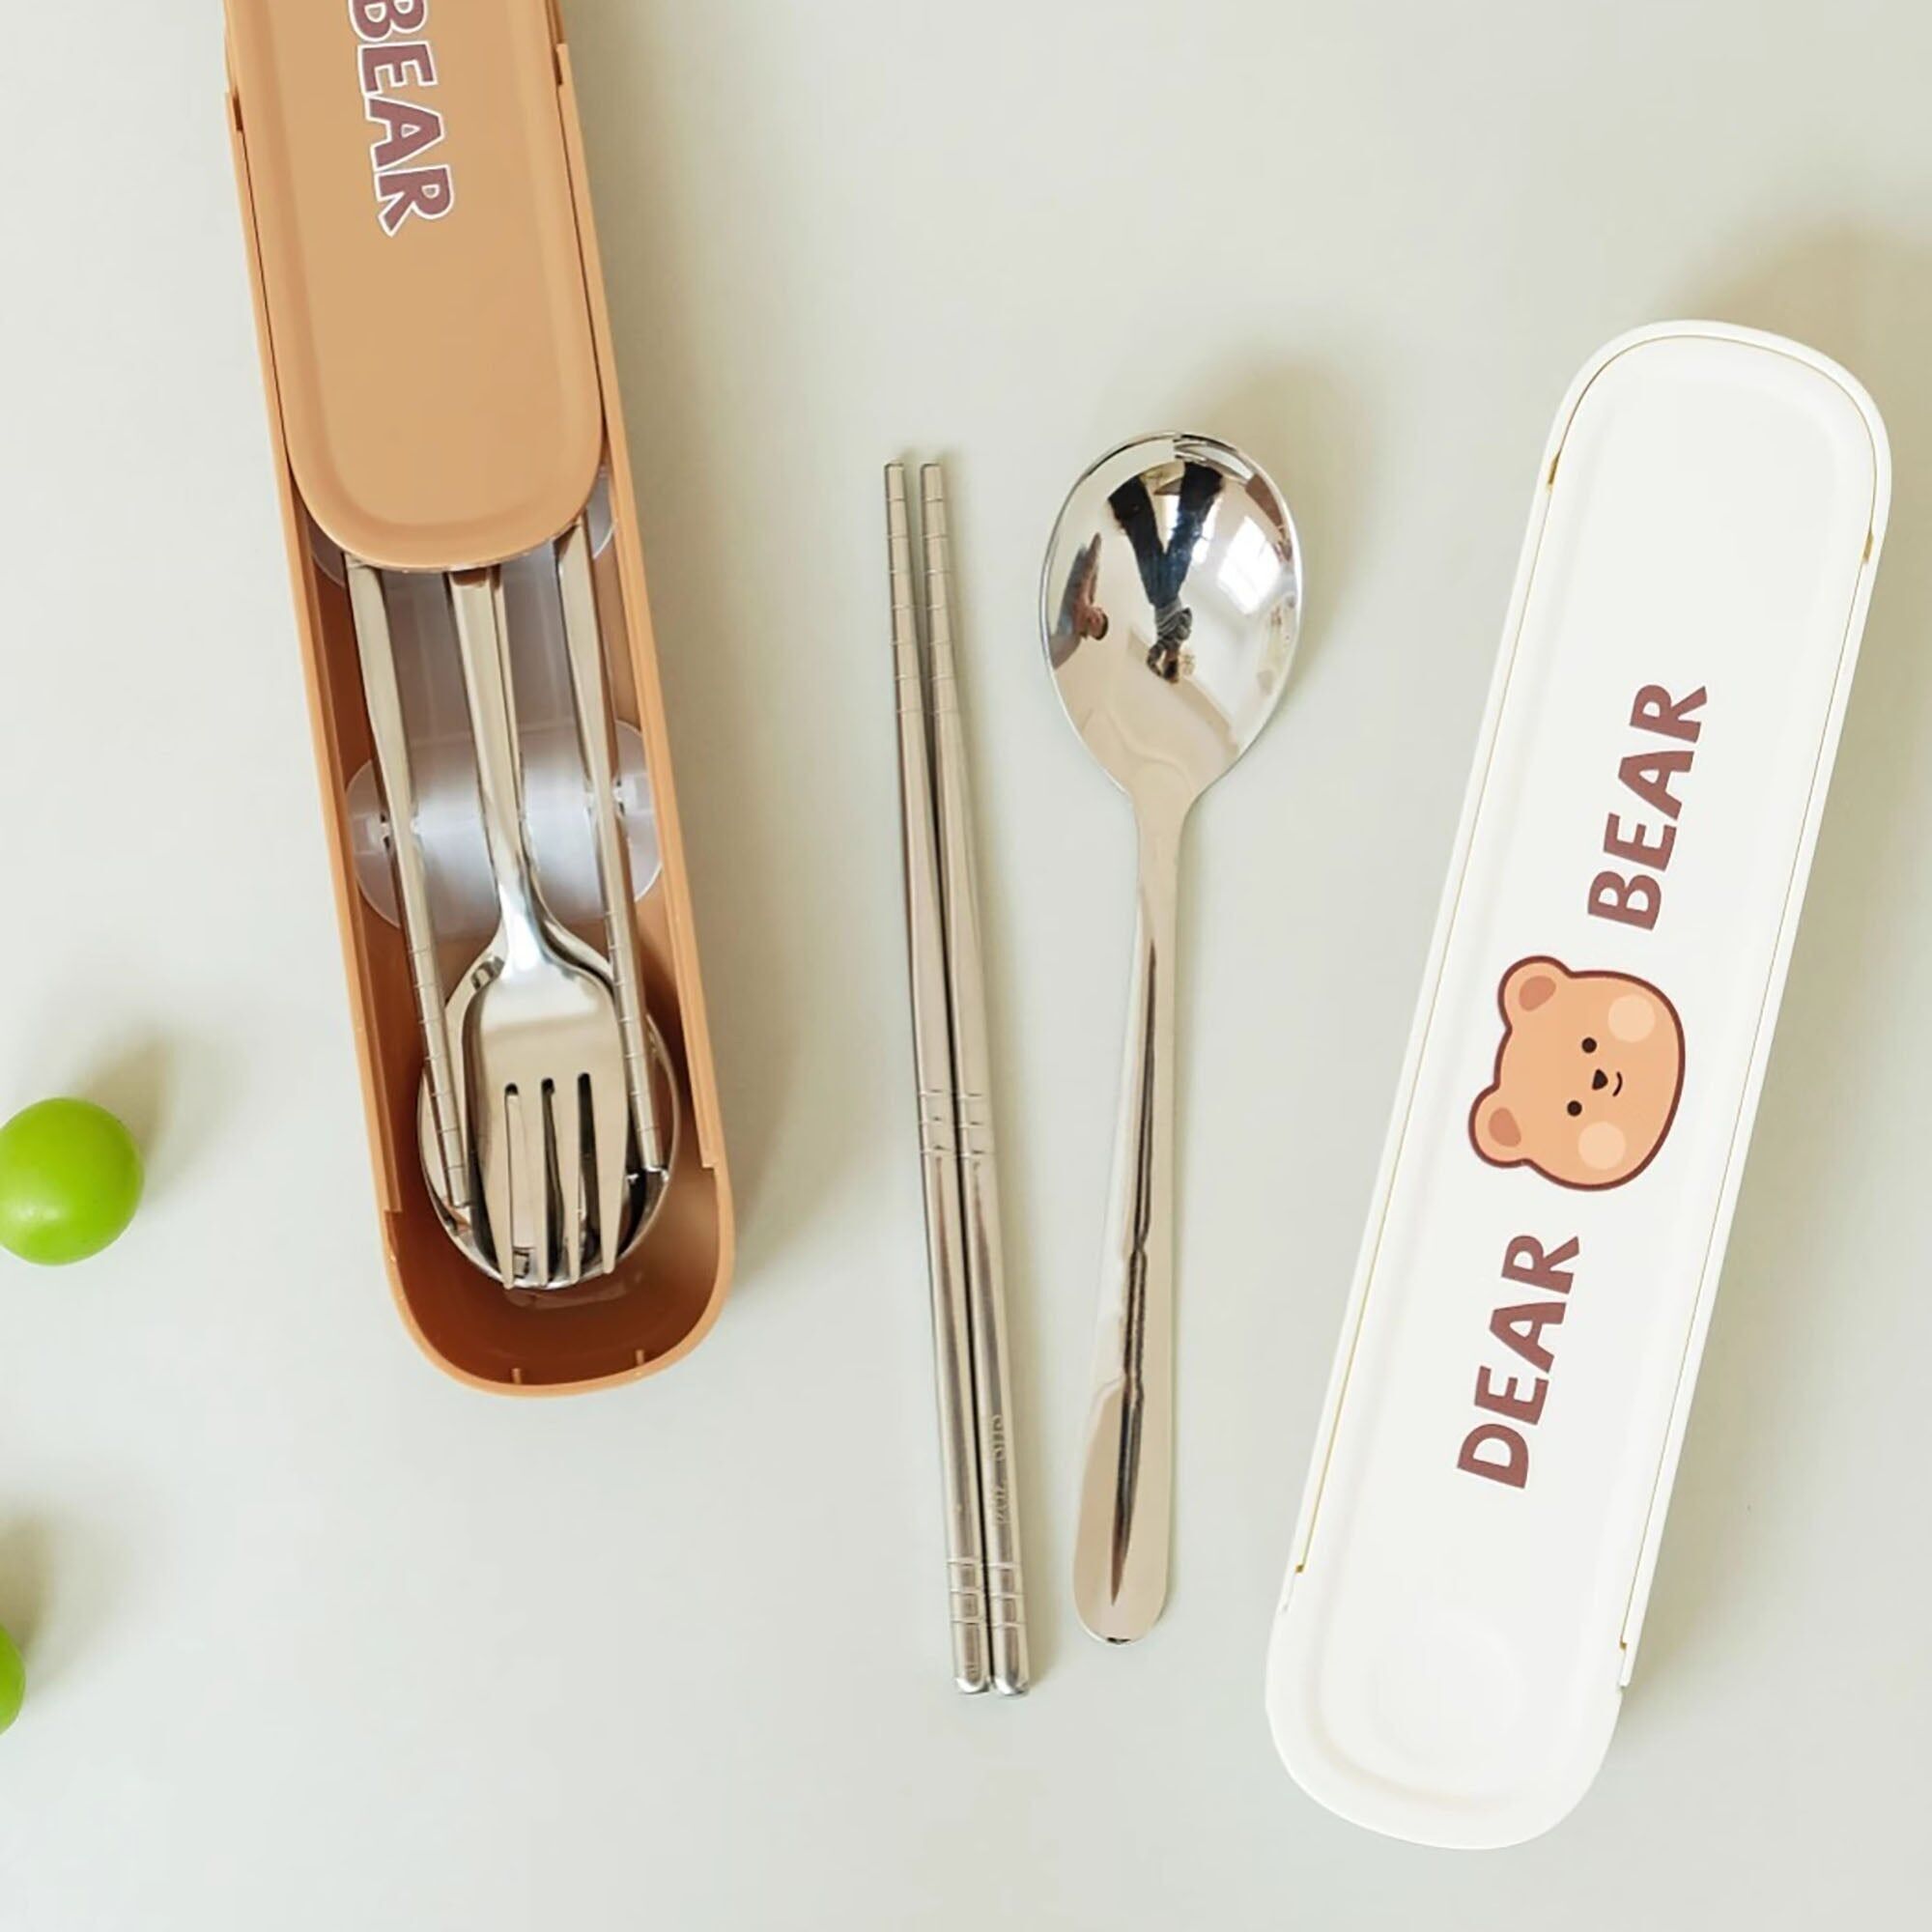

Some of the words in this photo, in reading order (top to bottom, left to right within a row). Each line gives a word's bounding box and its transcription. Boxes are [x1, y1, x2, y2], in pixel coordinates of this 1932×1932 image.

[349, 0, 454, 237] BEAR
[1457, 1235, 1579, 1489] DEAR
[1587, 684, 1708, 930] BEAR
